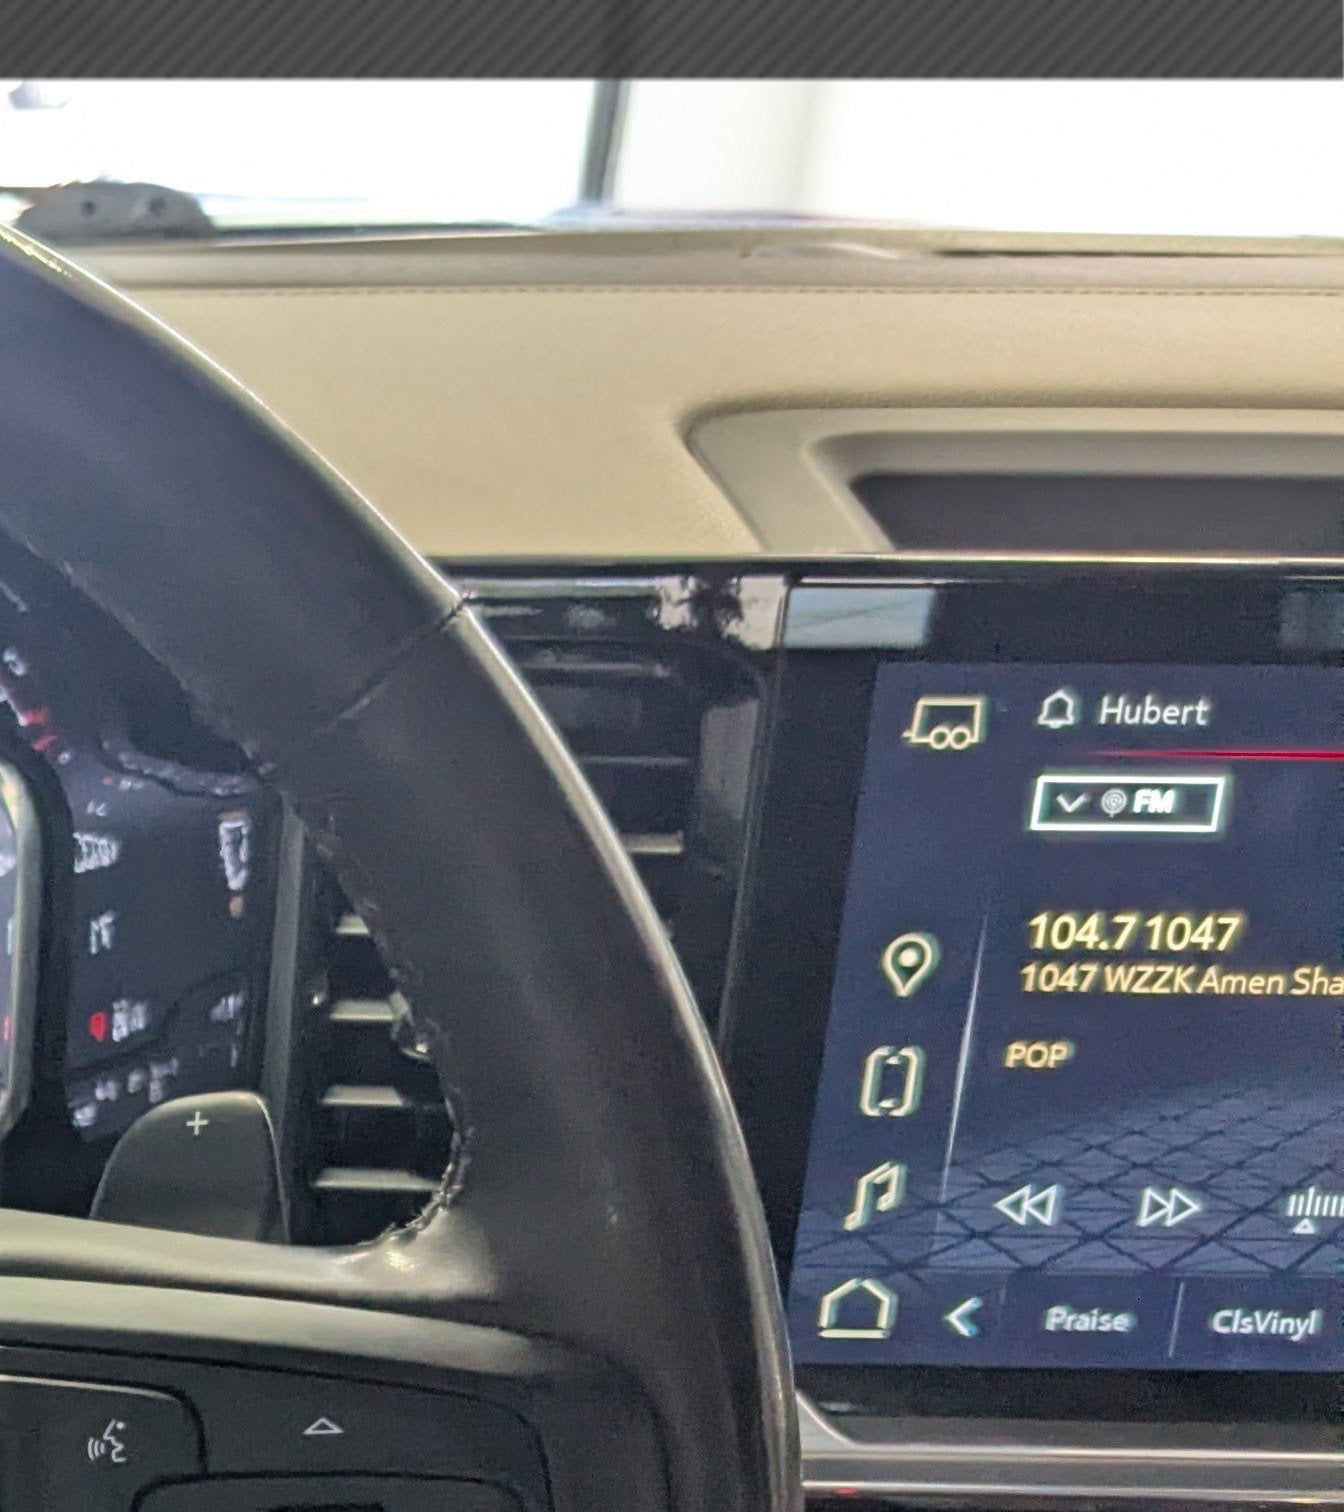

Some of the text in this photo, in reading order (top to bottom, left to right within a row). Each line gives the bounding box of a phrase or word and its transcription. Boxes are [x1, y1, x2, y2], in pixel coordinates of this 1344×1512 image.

[1098, 694, 1211, 726] Hubert
[1133, 789, 1177, 814] FM
[1028, 911, 1244, 951] 104.7 1047
[1020, 962, 1098, 993] 1047
[1103, 962, 1196, 994] WZZK
[1195, 963, 1286, 995] Amen
[1004, 1040, 1071, 1069] POP
[1043, 1305, 1134, 1333] Praise
[1212, 1308, 1320, 1342] ClsVinyl
